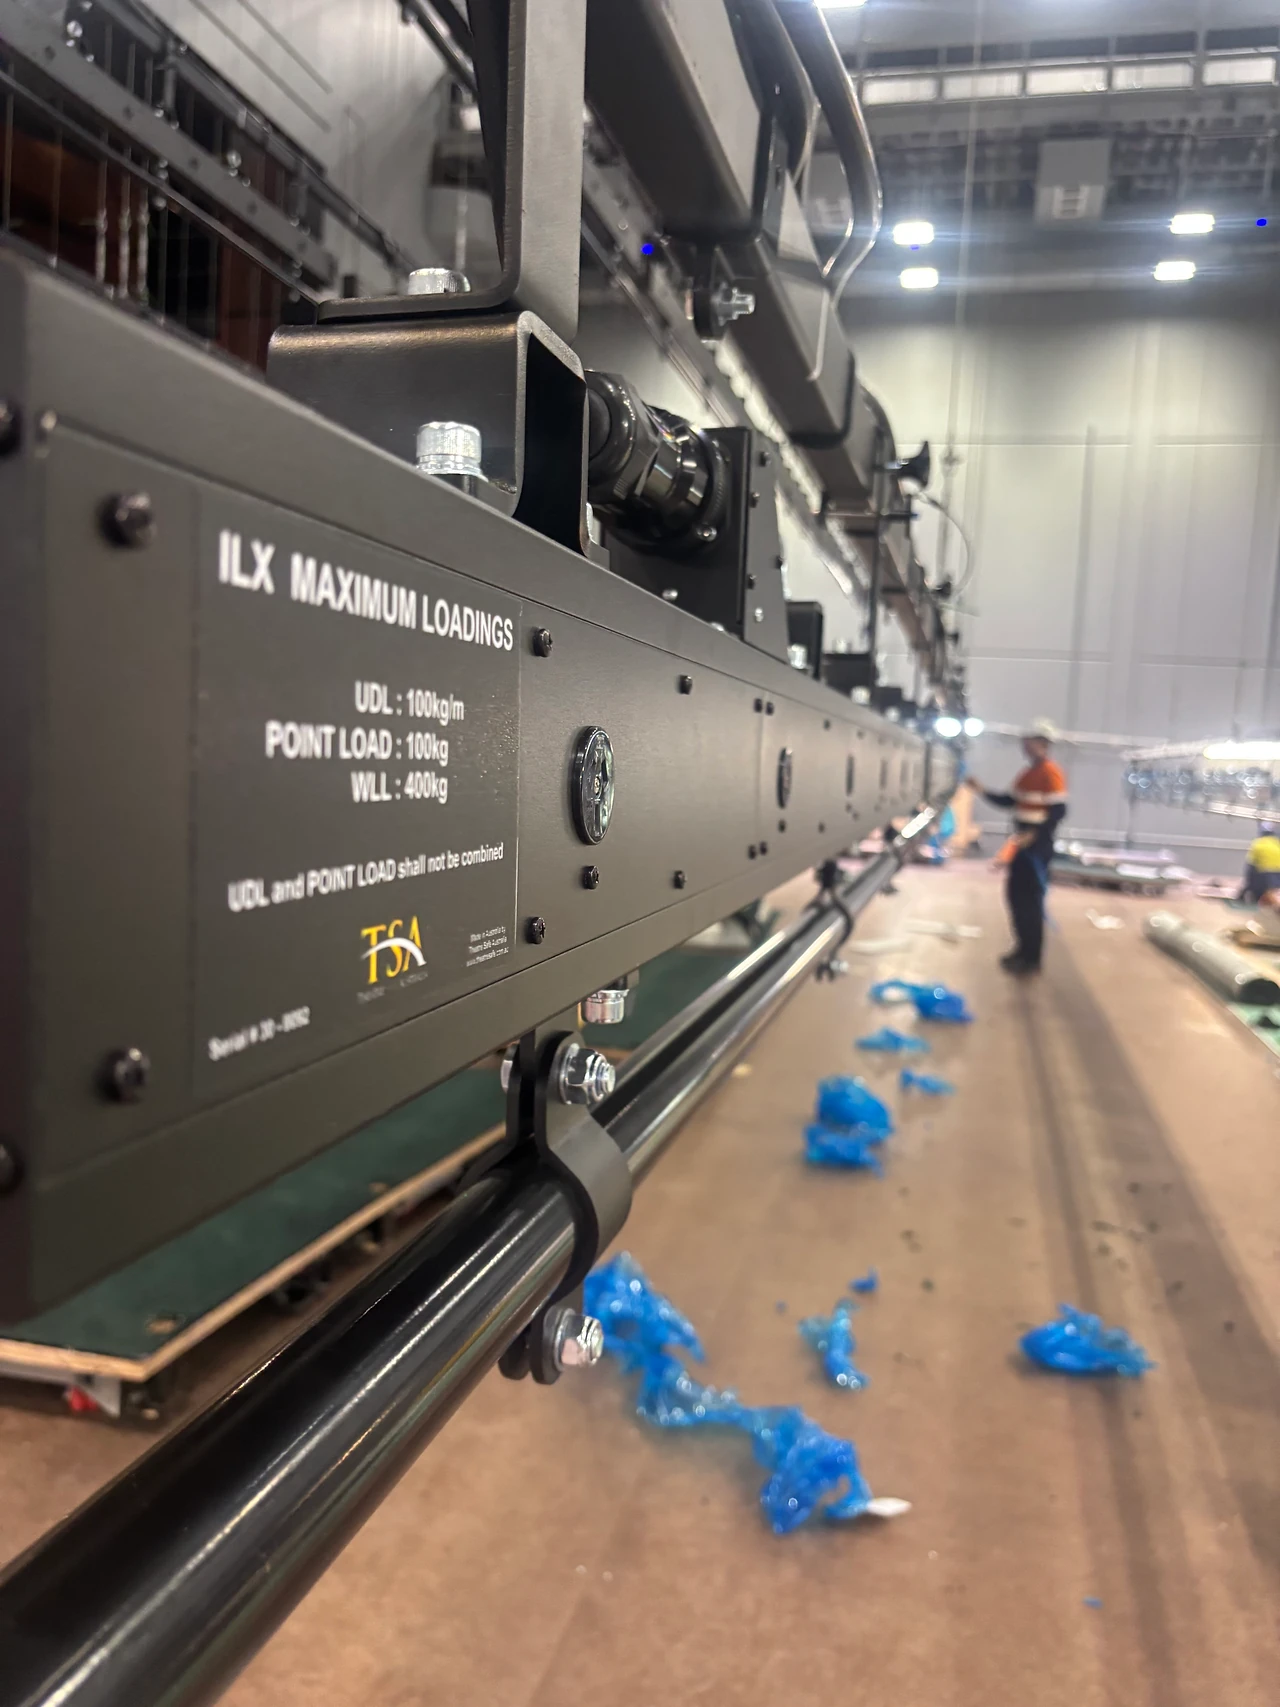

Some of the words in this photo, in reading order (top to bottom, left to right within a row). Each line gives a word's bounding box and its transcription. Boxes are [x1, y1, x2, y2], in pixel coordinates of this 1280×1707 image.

[219, 529, 275, 594] ILX
[290, 552, 416, 629] MAXIMUM
[422, 594, 514, 651] LOADINGS
[355, 680, 393, 715] UDL
[406, 688, 465, 726] 100kg/m
[265, 720, 335, 759] POINT
[339, 726, 392, 760] LOAD
[406, 731, 449, 767] 100kg
[351, 771, 392, 803] WLL
[404, 771, 448, 804] 400kg
[228, 878, 270, 912] UDL
[271, 872, 305, 904] and
[306, 864, 356, 897] POINT
[357, 858, 396, 887] LOAD
[397, 854, 426, 879] shall
[427, 852, 446, 873] not
[446, 850, 460, 869] be
[461, 841, 504, 866] combined
[361, 915, 425, 984] TSA
